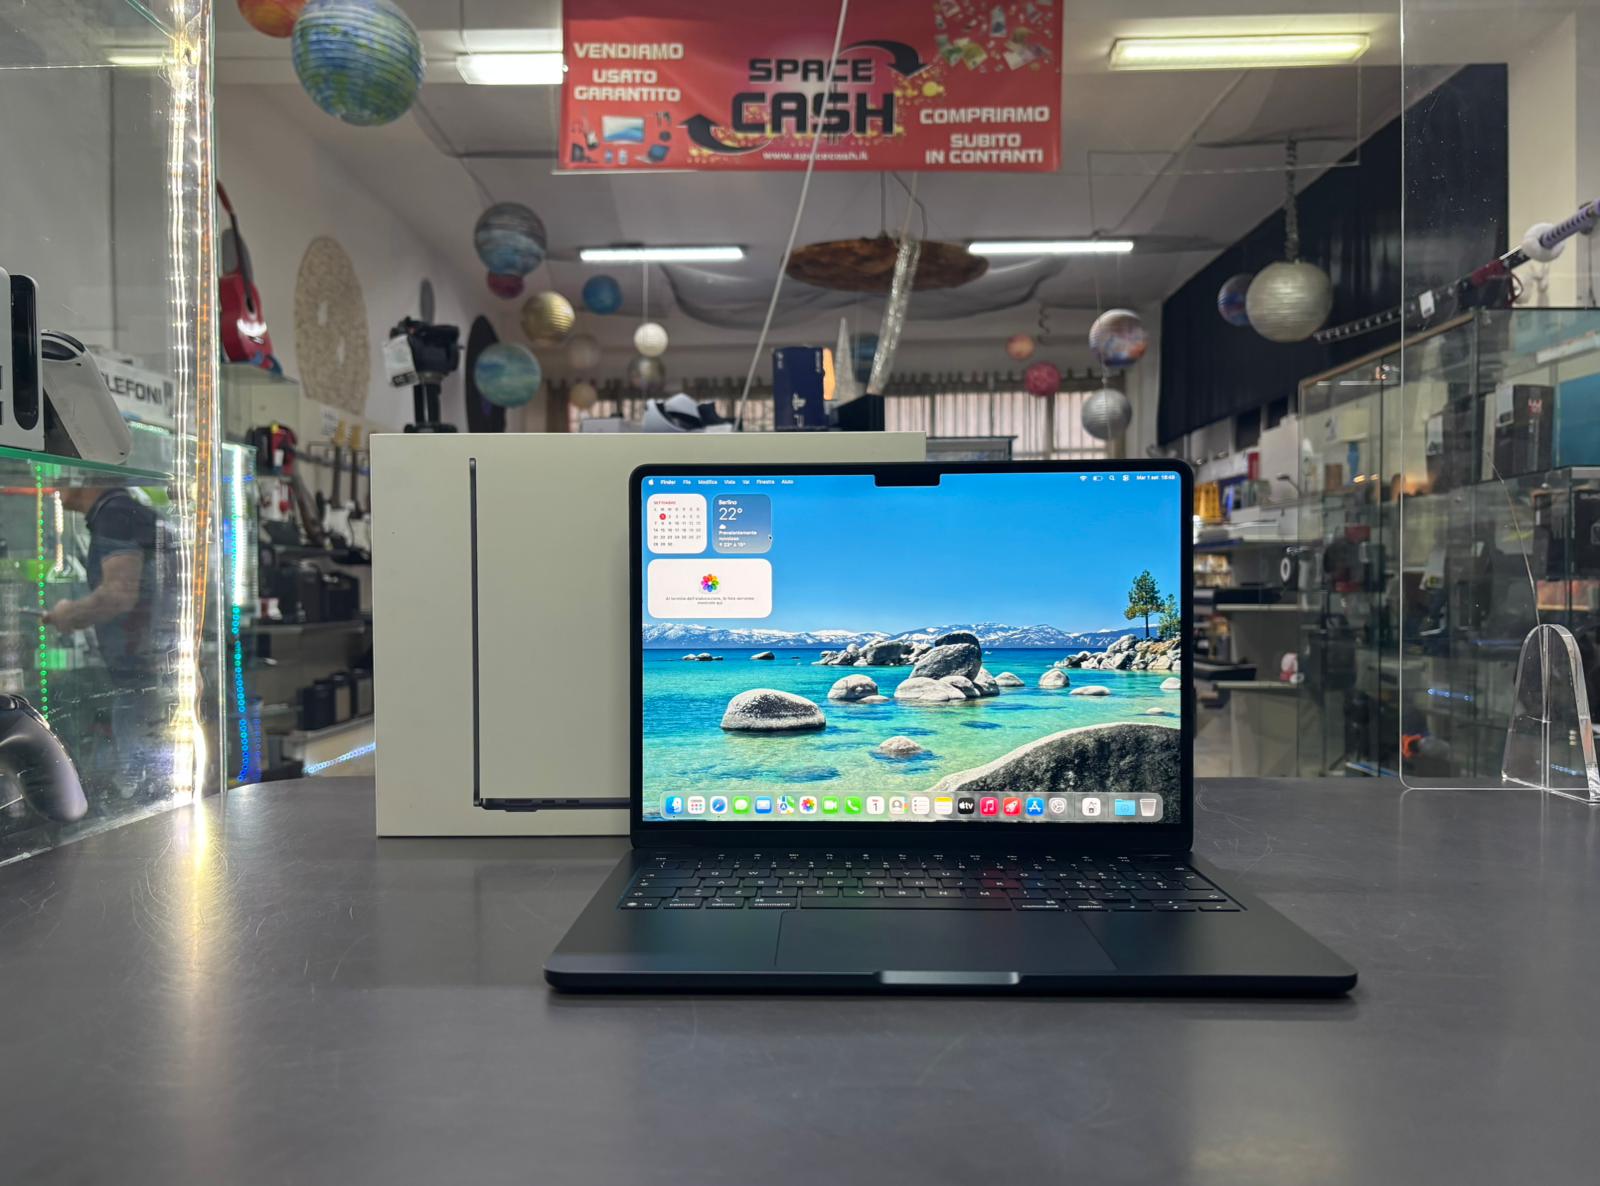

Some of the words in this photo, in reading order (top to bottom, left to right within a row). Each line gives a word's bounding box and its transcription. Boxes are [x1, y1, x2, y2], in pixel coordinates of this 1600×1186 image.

[573, 42, 684, 60] VENDIAMO
[592, 68, 657, 84] USATO
[749, 59, 873, 82] SPACE
[574, 86, 681, 102] GARANTITO
[920, 106, 1050, 124] COMPRIAMO
[950, 133, 1021, 148] SUBITO
[925, 149, 945, 164] IN
[949, 148, 1044, 164] CONTANTI
[101, 371, 163, 405] LEFONI
[719, 507, 743, 520] 22°
